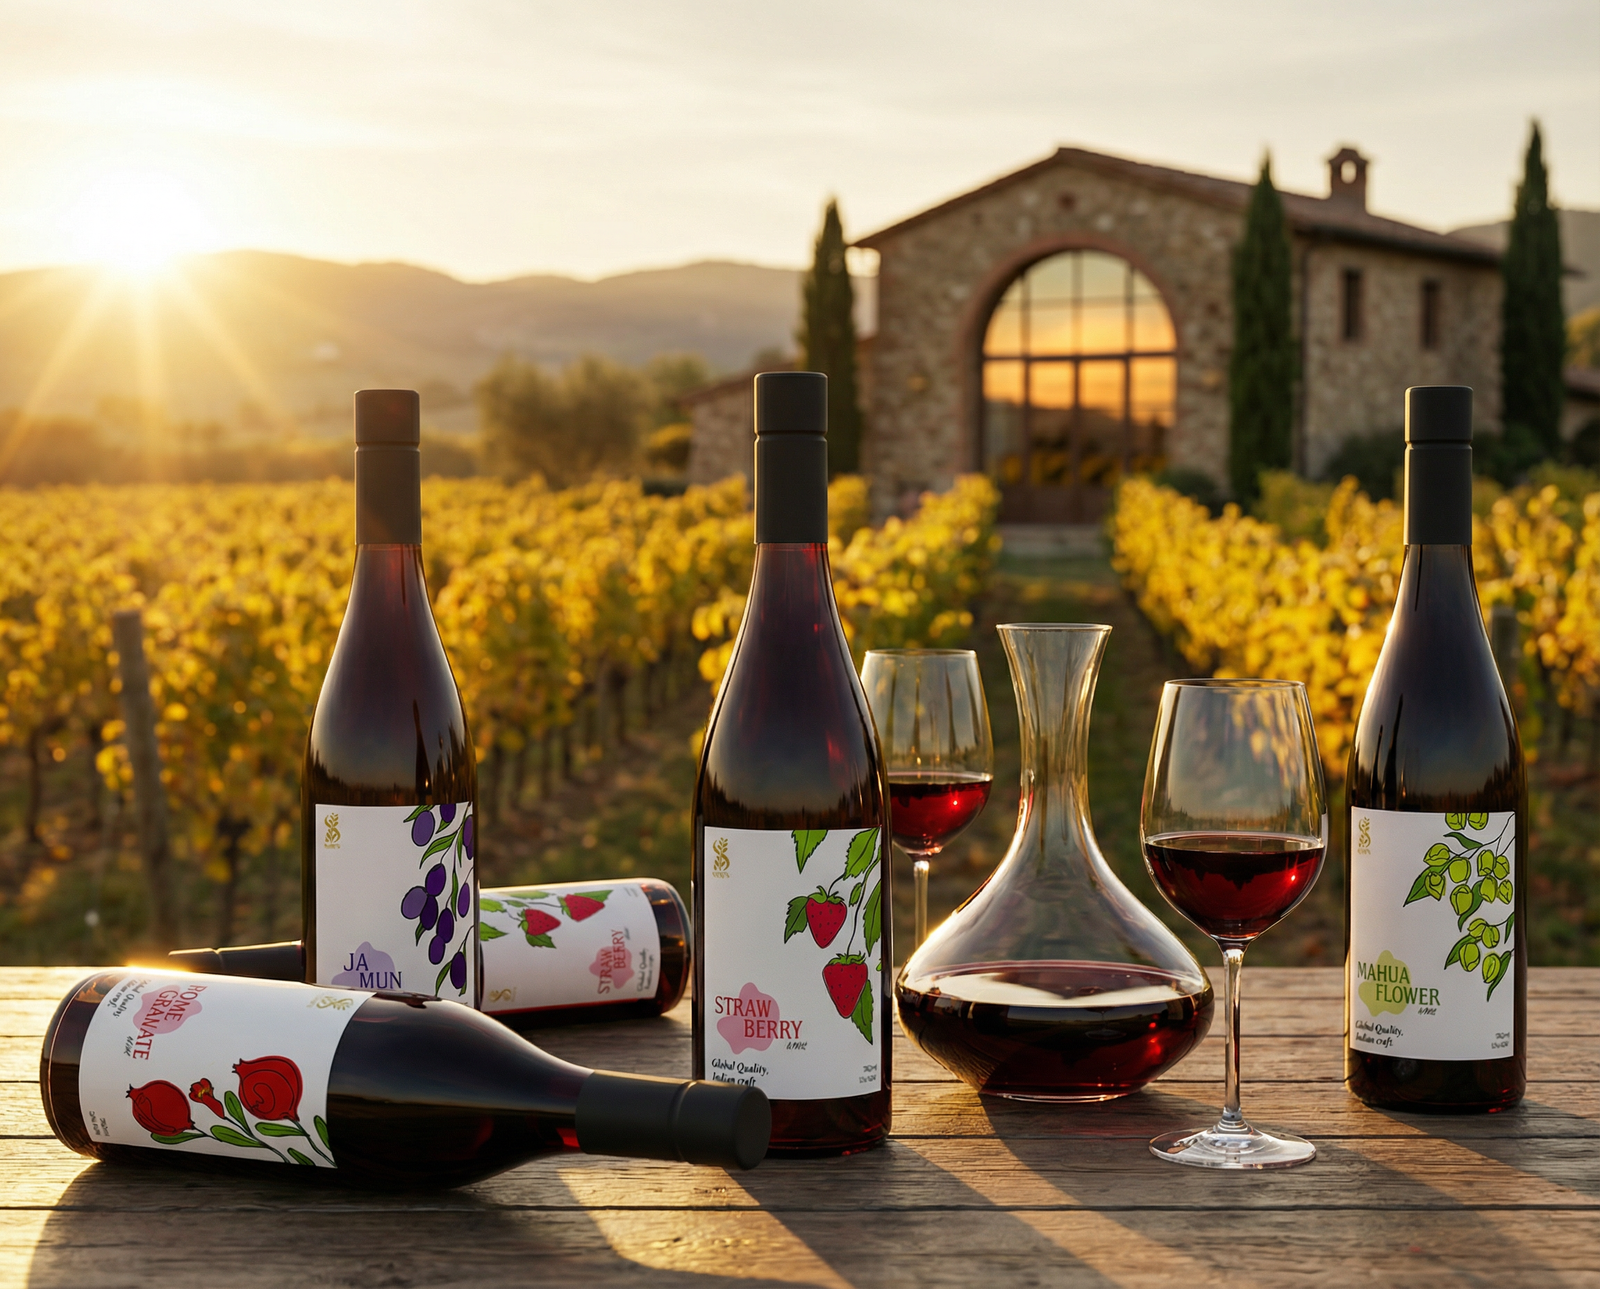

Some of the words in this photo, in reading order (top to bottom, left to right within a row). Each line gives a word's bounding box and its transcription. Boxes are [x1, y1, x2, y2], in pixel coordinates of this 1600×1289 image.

[610, 928, 626, 969] BERRY
[343, 952, 369, 972] JA
[597, 949, 613, 994] STRAW
[1357, 961, 1410, 984] MAHUA
[359, 971, 402, 989] MUN
[1375, 983, 1441, 1006] FLOWER
[715, 995, 772, 1018] STRAW
[132, 990, 179, 1060] GRANATE
[744, 1018, 803, 1040] BERRY
[737, 1062, 769, 1077] Quality,
